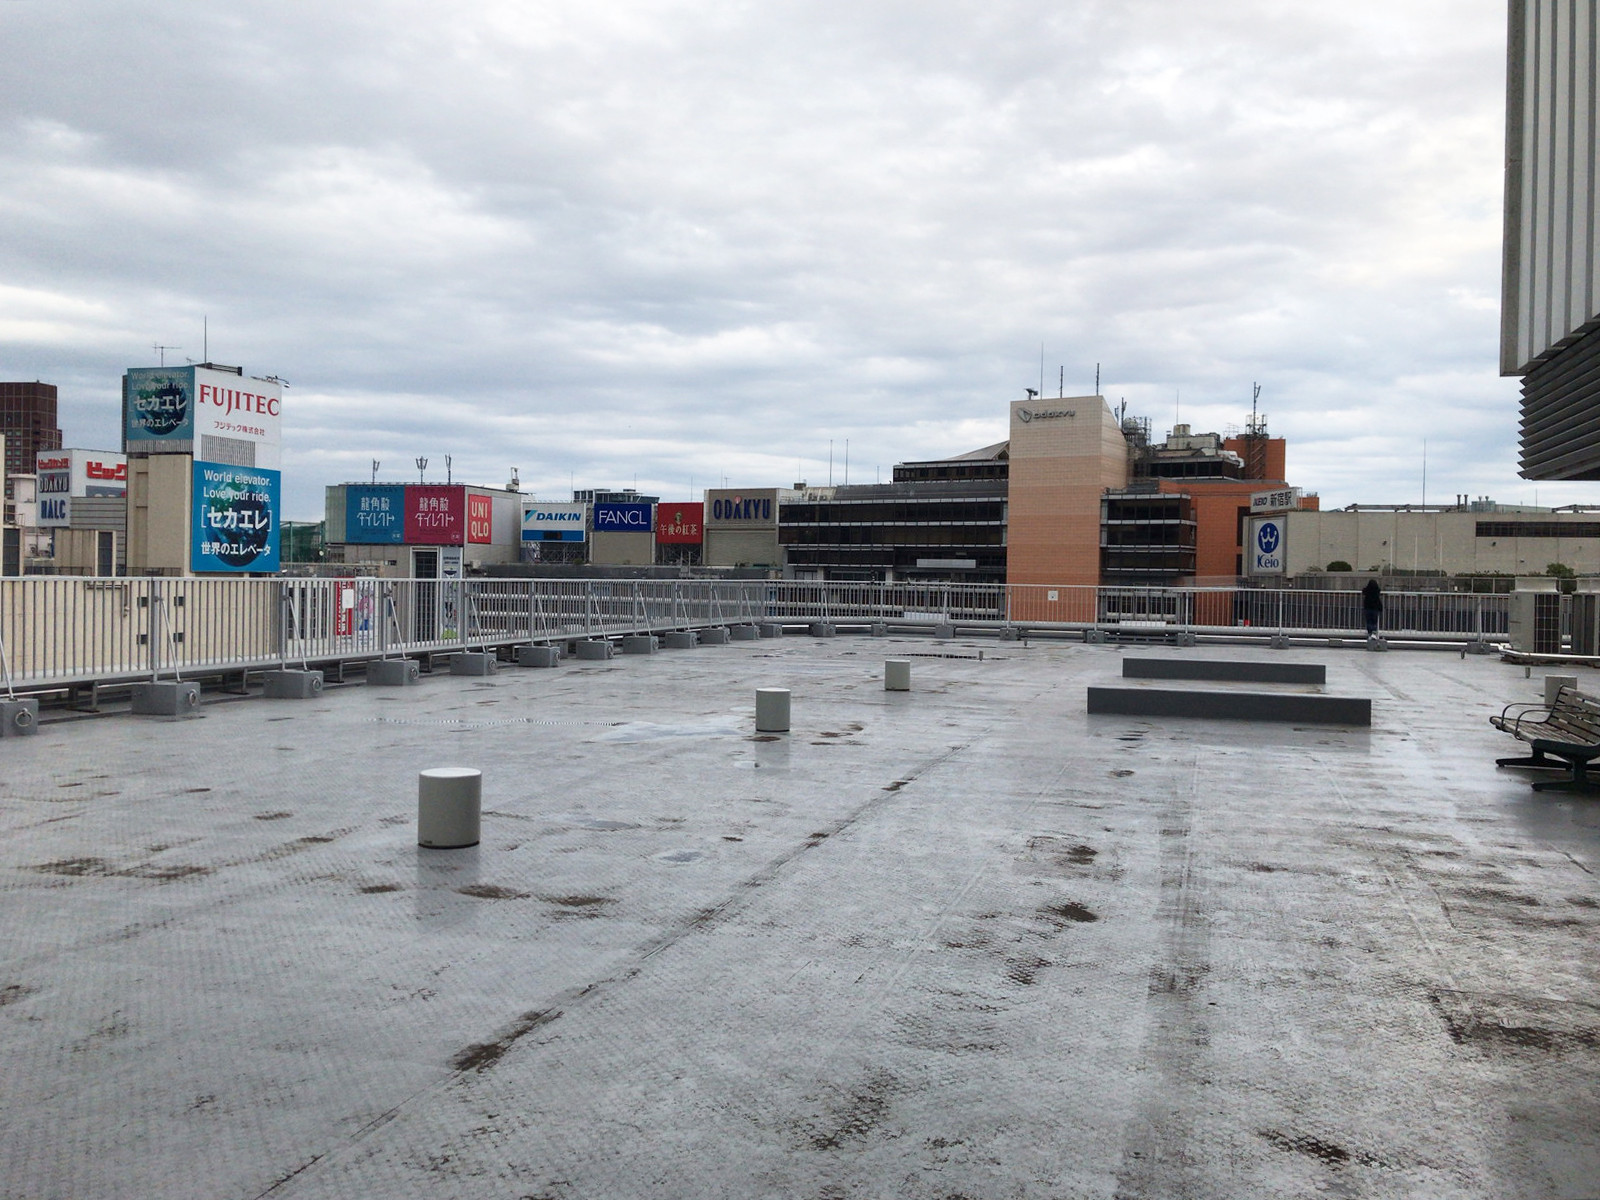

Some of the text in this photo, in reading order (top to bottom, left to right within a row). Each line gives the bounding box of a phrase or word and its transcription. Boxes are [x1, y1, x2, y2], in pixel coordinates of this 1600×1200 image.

[199, 384, 280, 416] FUJITEC
[214, 421, 265, 436] フジテック株式会社
[203, 469, 272, 487] World elevator.
[203, 487, 271, 502] Love your ride.
[41, 499, 66, 519] HALC
[471, 501, 488, 518] UNI
[713, 497, 771, 519] ODAKYU
[536, 512, 581, 521] DAIKIN
[598, 510, 647, 525] FANCL
[471, 521, 489, 539] QLO
[660, 524, 698, 537] 午後の紅茶
[201, 541, 271, 557] 世界のエレベータ
[1257, 554, 1279, 568] Keio
